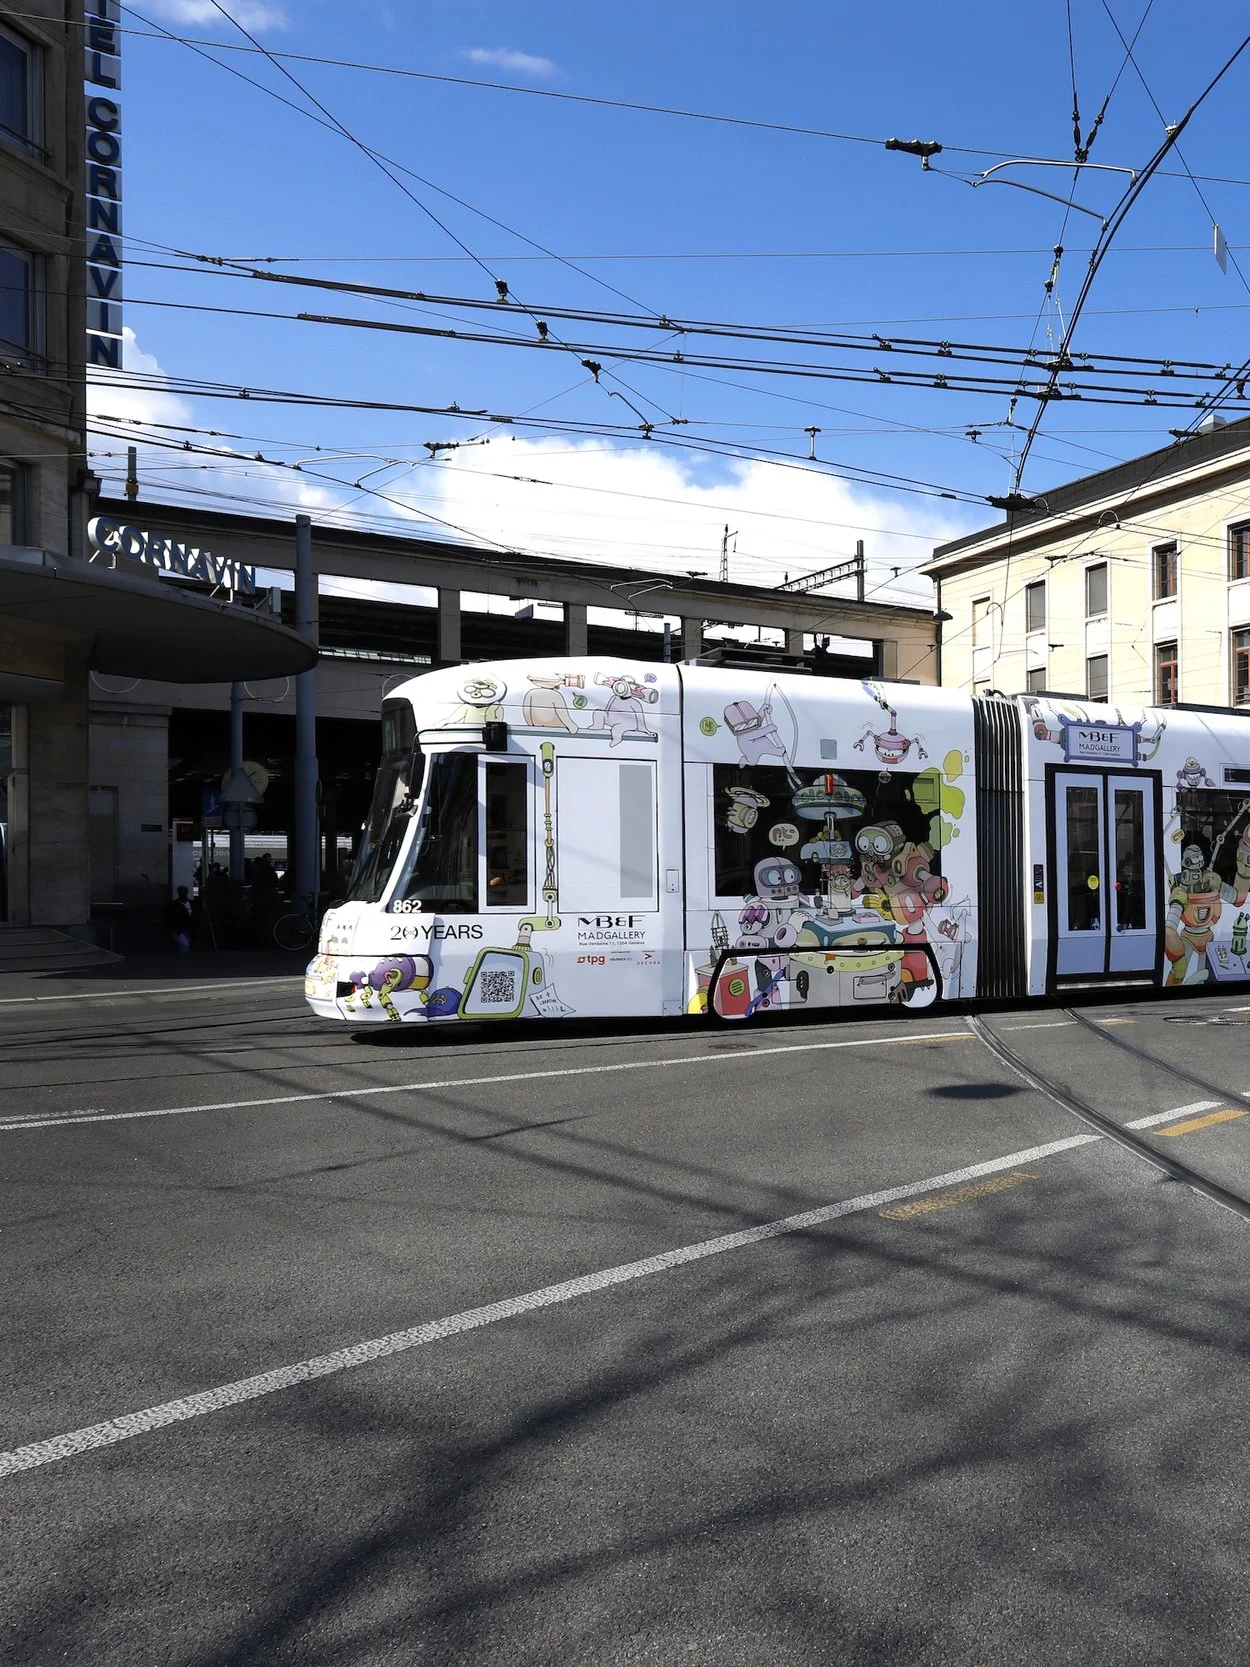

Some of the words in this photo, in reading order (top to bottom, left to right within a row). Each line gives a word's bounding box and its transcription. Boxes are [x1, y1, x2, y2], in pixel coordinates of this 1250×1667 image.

[87, 97, 120, 367] CORNAVIN
[88, 516, 256, 596] CORNAVIN
[1079, 731, 1120, 743] MB&F
[392, 900, 422, 913] 862
[577, 915, 645, 929] MB&F
[587, 954, 605, 965] tpg
